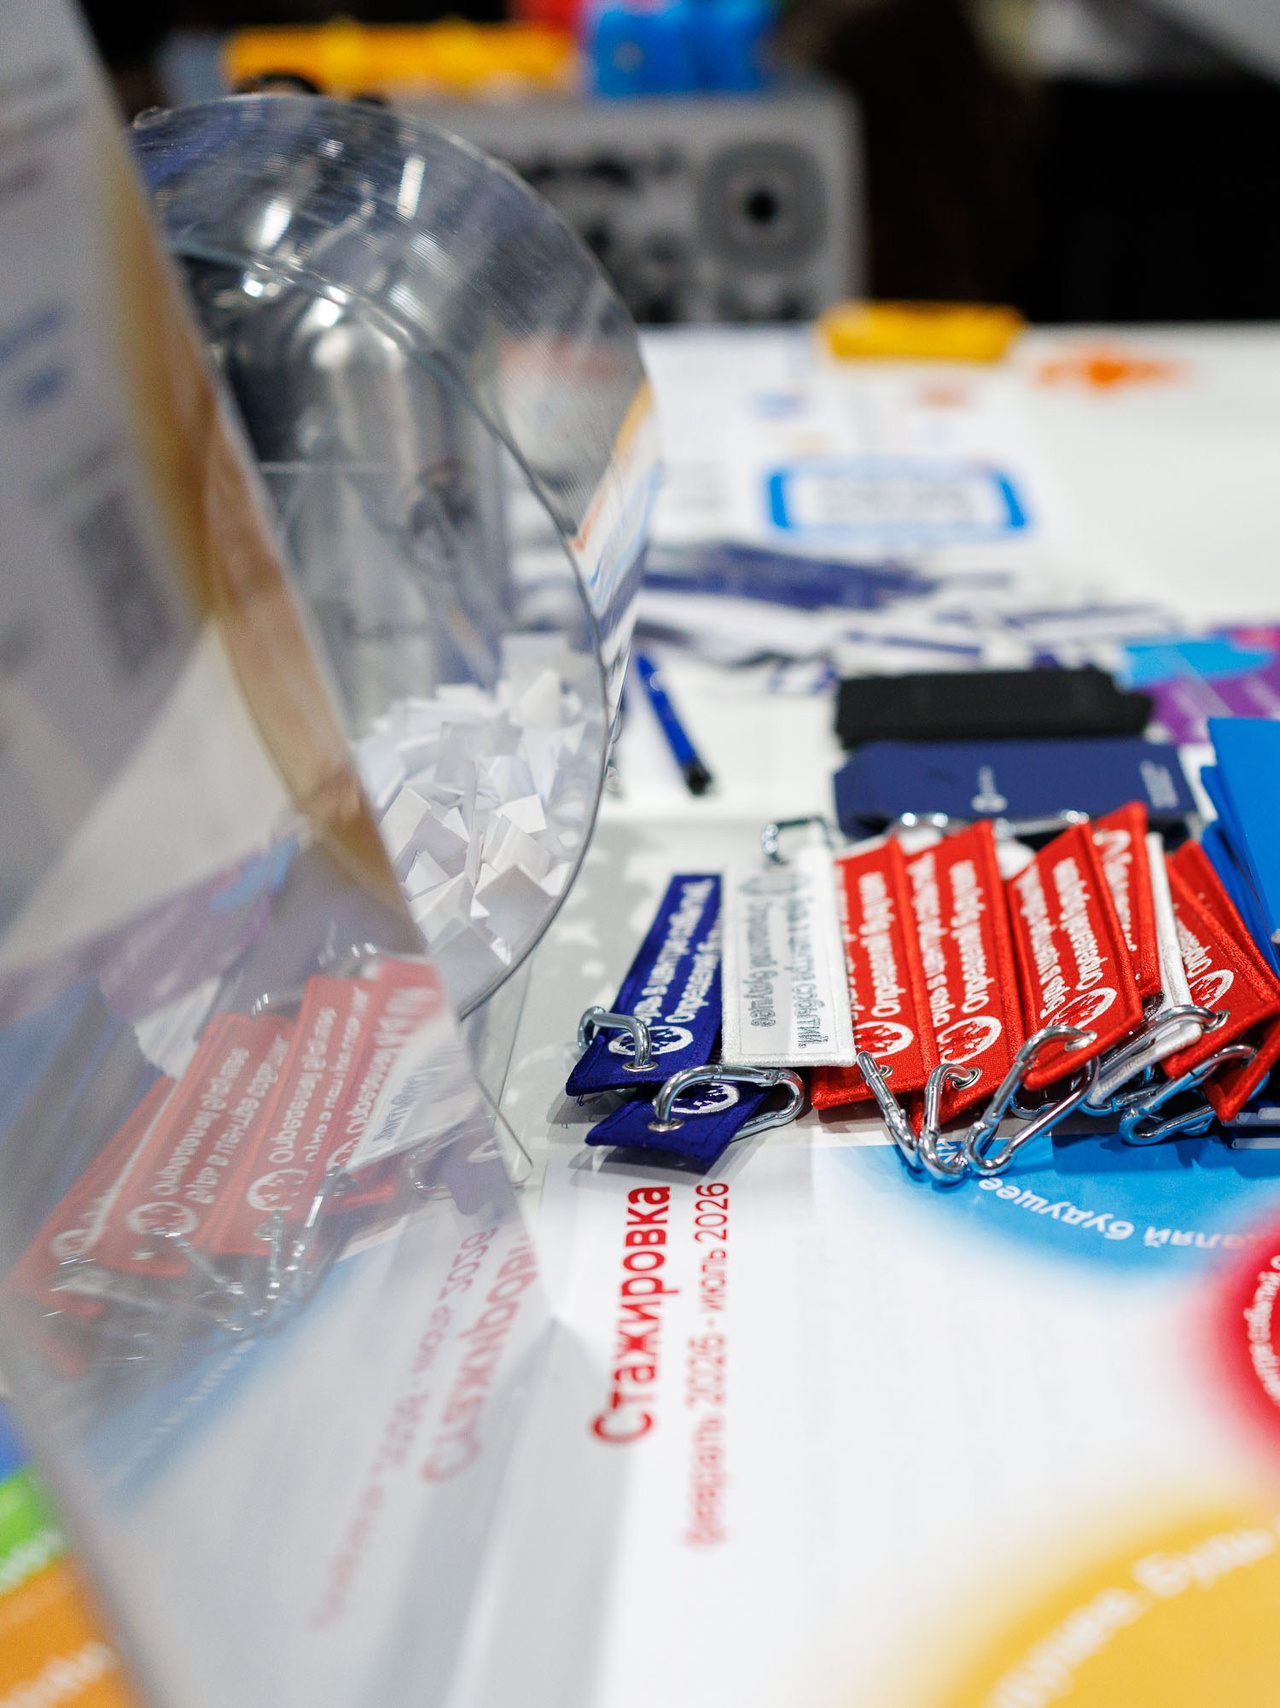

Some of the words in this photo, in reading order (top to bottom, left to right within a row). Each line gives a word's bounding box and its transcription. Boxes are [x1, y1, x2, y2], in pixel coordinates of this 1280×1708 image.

[1060, 909, 1108, 991] Определяй
[742, 968, 779, 1028] будущее
[791, 982, 829, 1049] событий.
[1040, 975, 1070, 1020] Будь
[694, 1182, 730, 1244] 2026
[699, 1247, 728, 1313] июль
[590, 1185, 680, 1443] Стажировка
